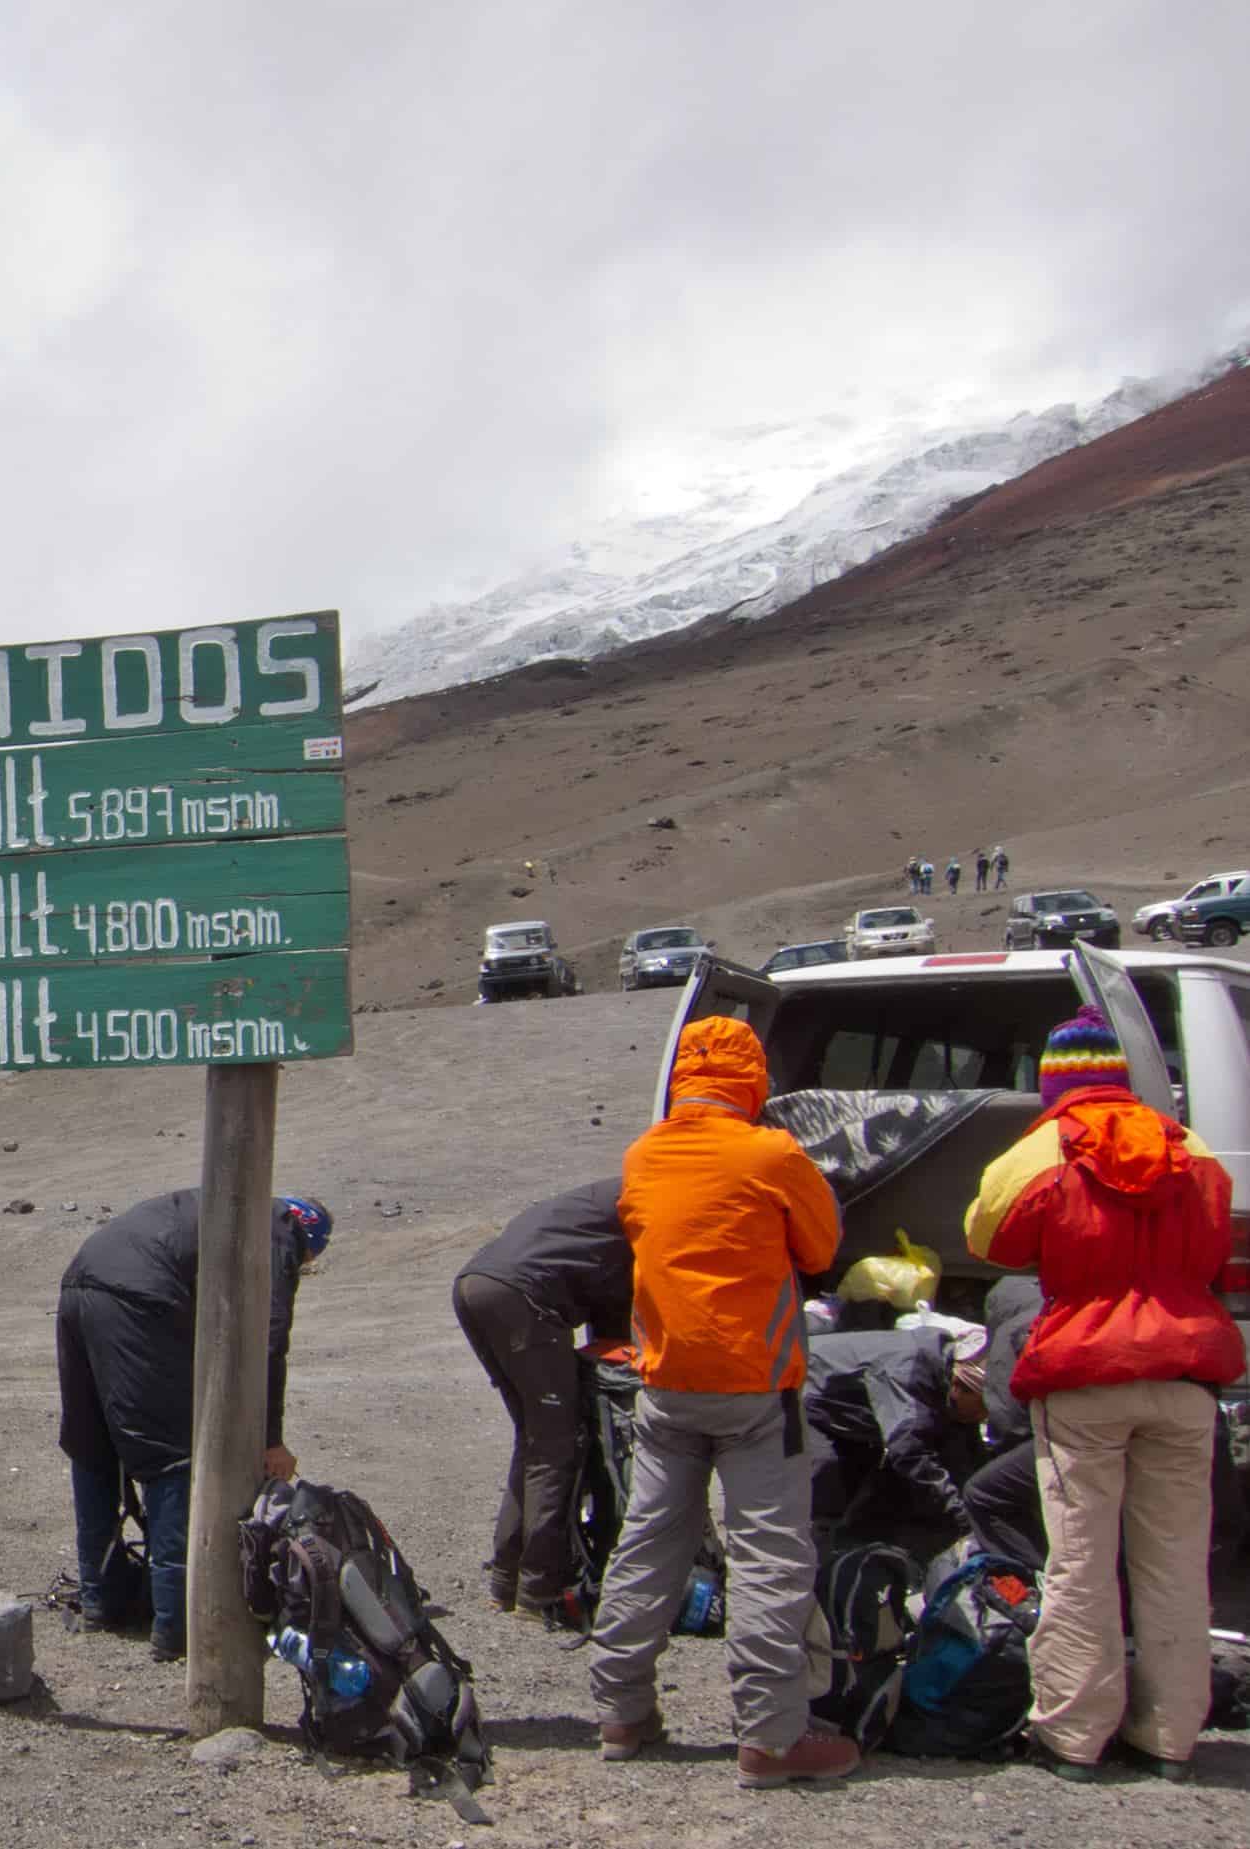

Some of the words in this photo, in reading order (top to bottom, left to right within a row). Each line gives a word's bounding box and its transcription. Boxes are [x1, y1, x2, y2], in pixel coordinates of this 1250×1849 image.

[68, 785, 174, 844] 5.897
[73, 898, 179, 956] 4.800
[76, 1009, 179, 1063] 4.500
